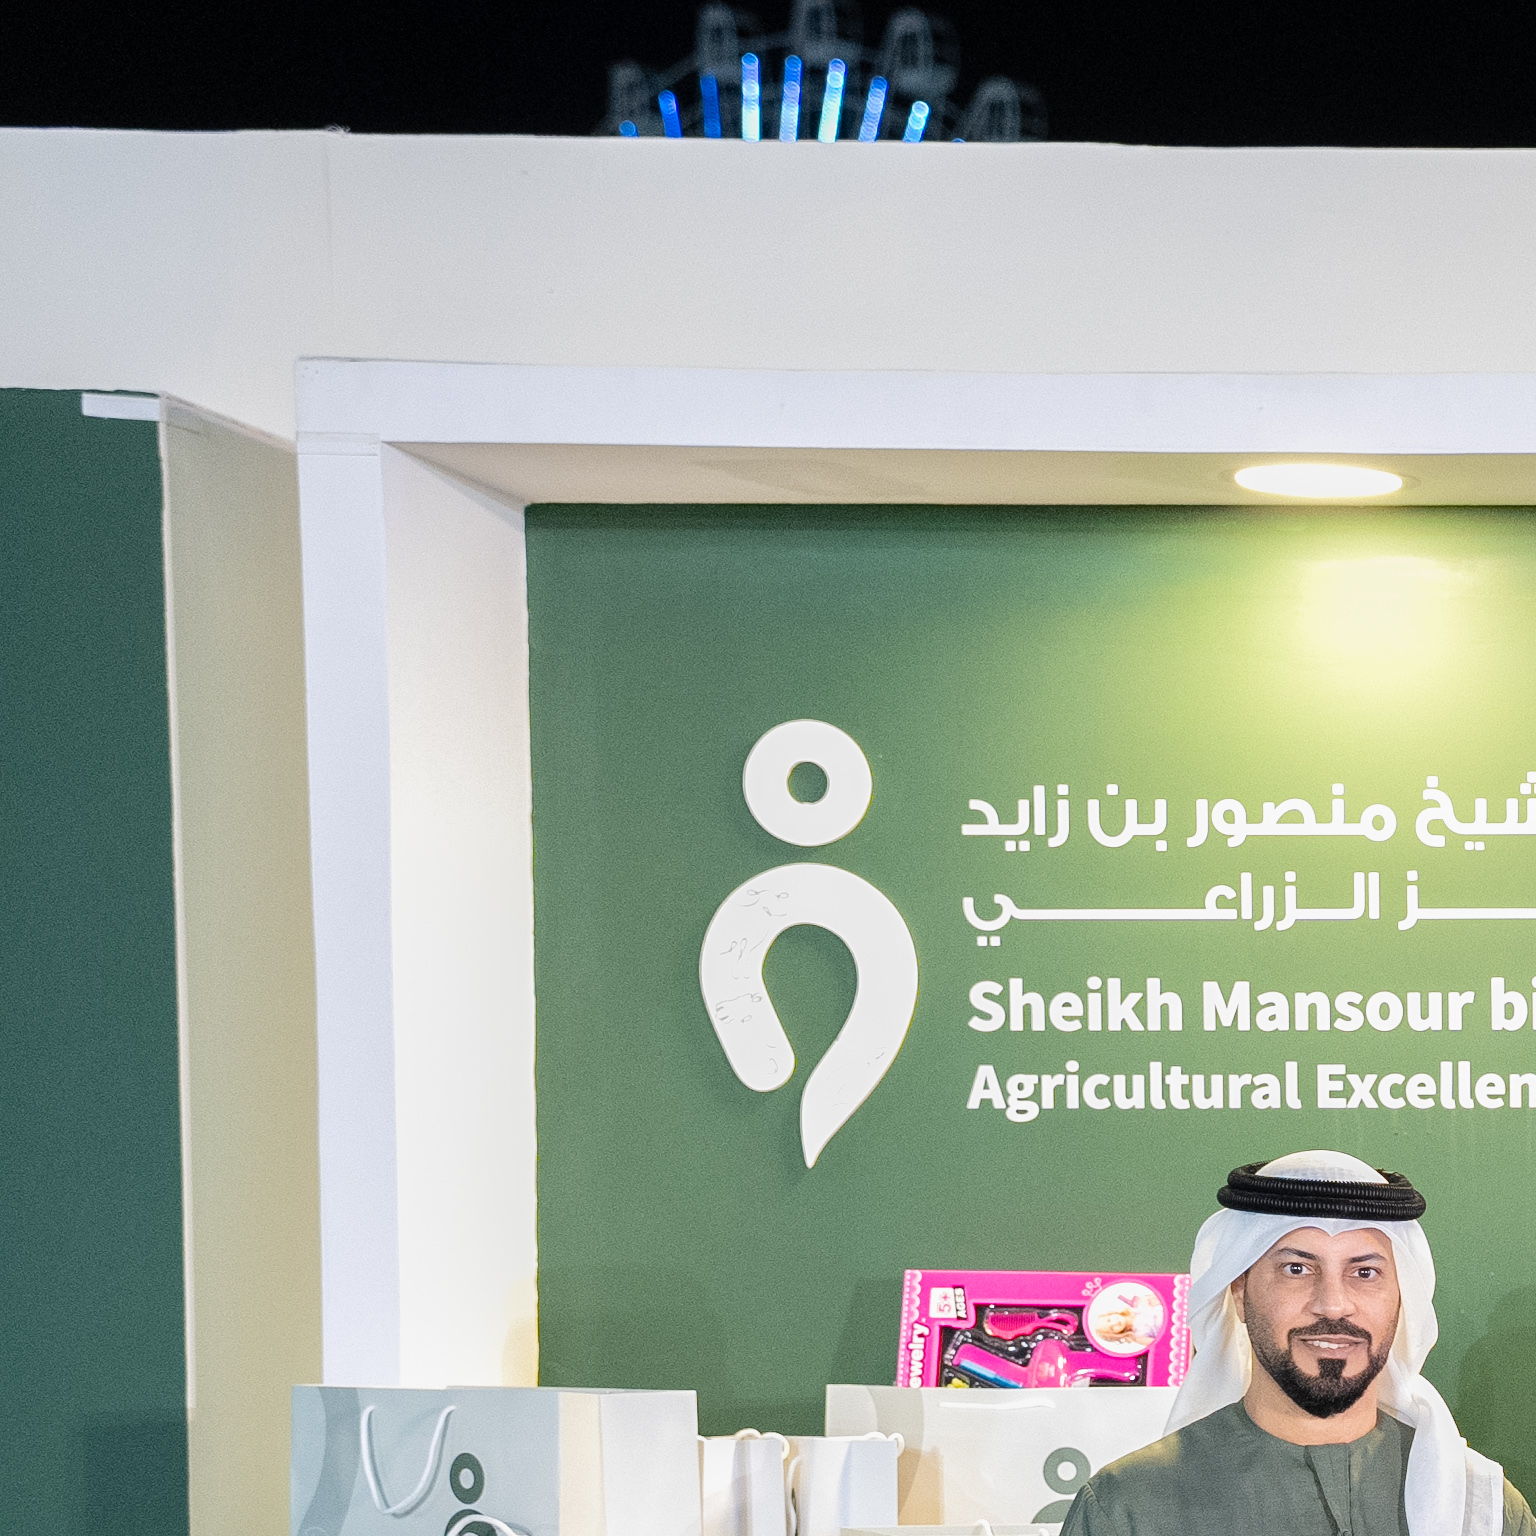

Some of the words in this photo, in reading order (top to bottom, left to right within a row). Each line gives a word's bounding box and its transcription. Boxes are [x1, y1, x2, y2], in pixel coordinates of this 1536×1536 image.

[961, 783, 1070, 852] زايد
[1087, 783, 1168, 851] بن
[1186, 783, 1397, 847] منصور
[962, 871, 1380, 946] الزراعي
[968, 976, 1183, 1032] Sheikh
[1202, 980, 1475, 1032] Mansour
[966, 1060, 1302, 1122] Agricultural
[954, 1287, 967, 1319] AGES
[908, 1322, 930, 1388] ewelry
